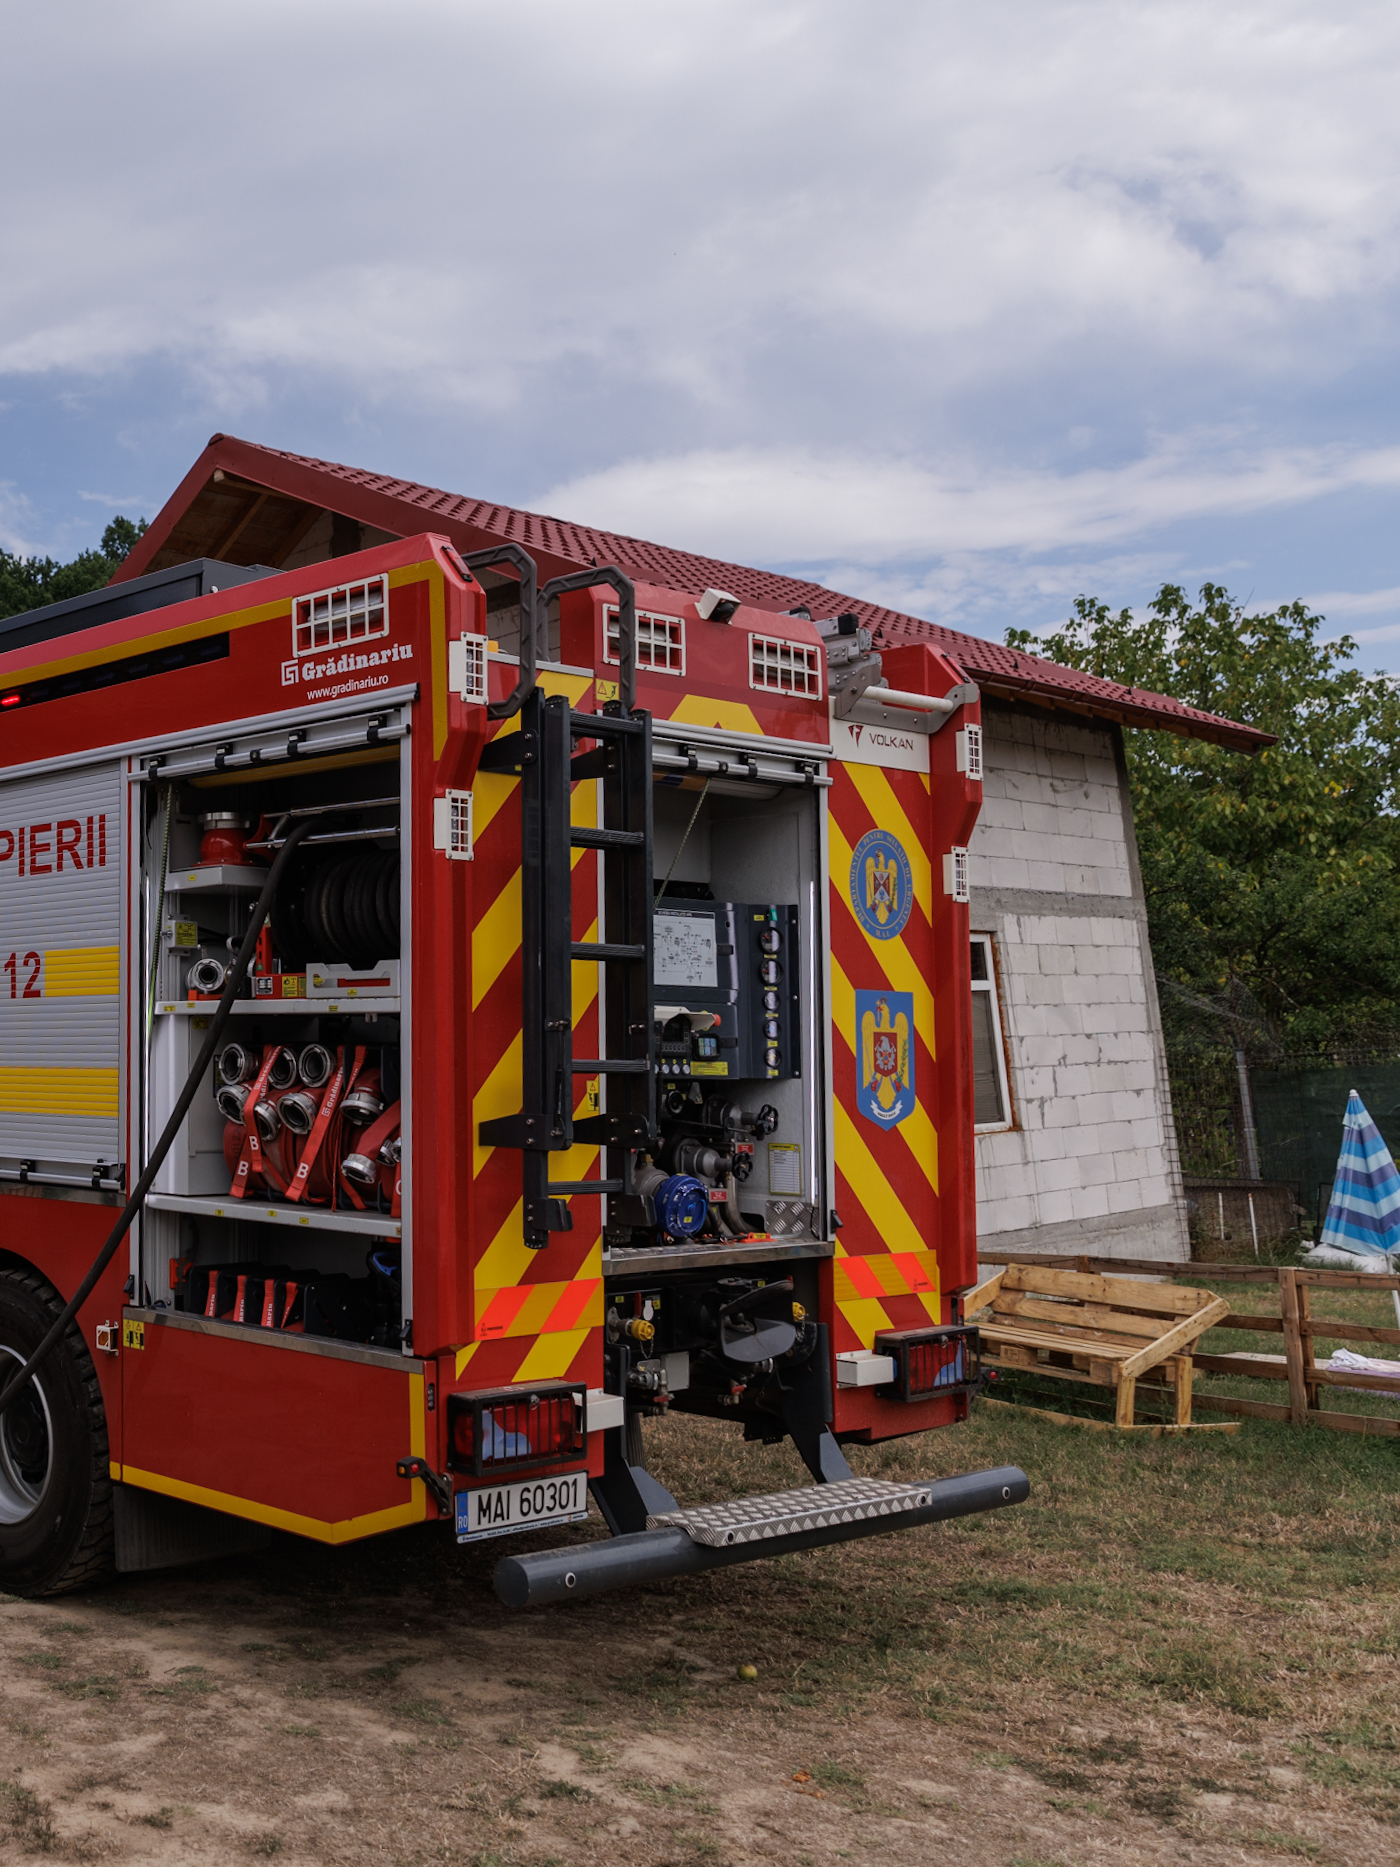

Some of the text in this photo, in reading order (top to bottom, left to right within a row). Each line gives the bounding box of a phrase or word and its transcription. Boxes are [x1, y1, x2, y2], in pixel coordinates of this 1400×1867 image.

[302, 643, 413, 681] Grădinariu
[307, 674, 389, 700] www.gradinariu.ro
[869, 733, 913, 750] VOLKAN
[249, 1135, 259, 1151] B
[237, 1160, 249, 1176] B
[296, 1163, 309, 1179] B
[477, 1478, 577, 1526] MAI 60301
[458, 1516, 468, 1529] RO
